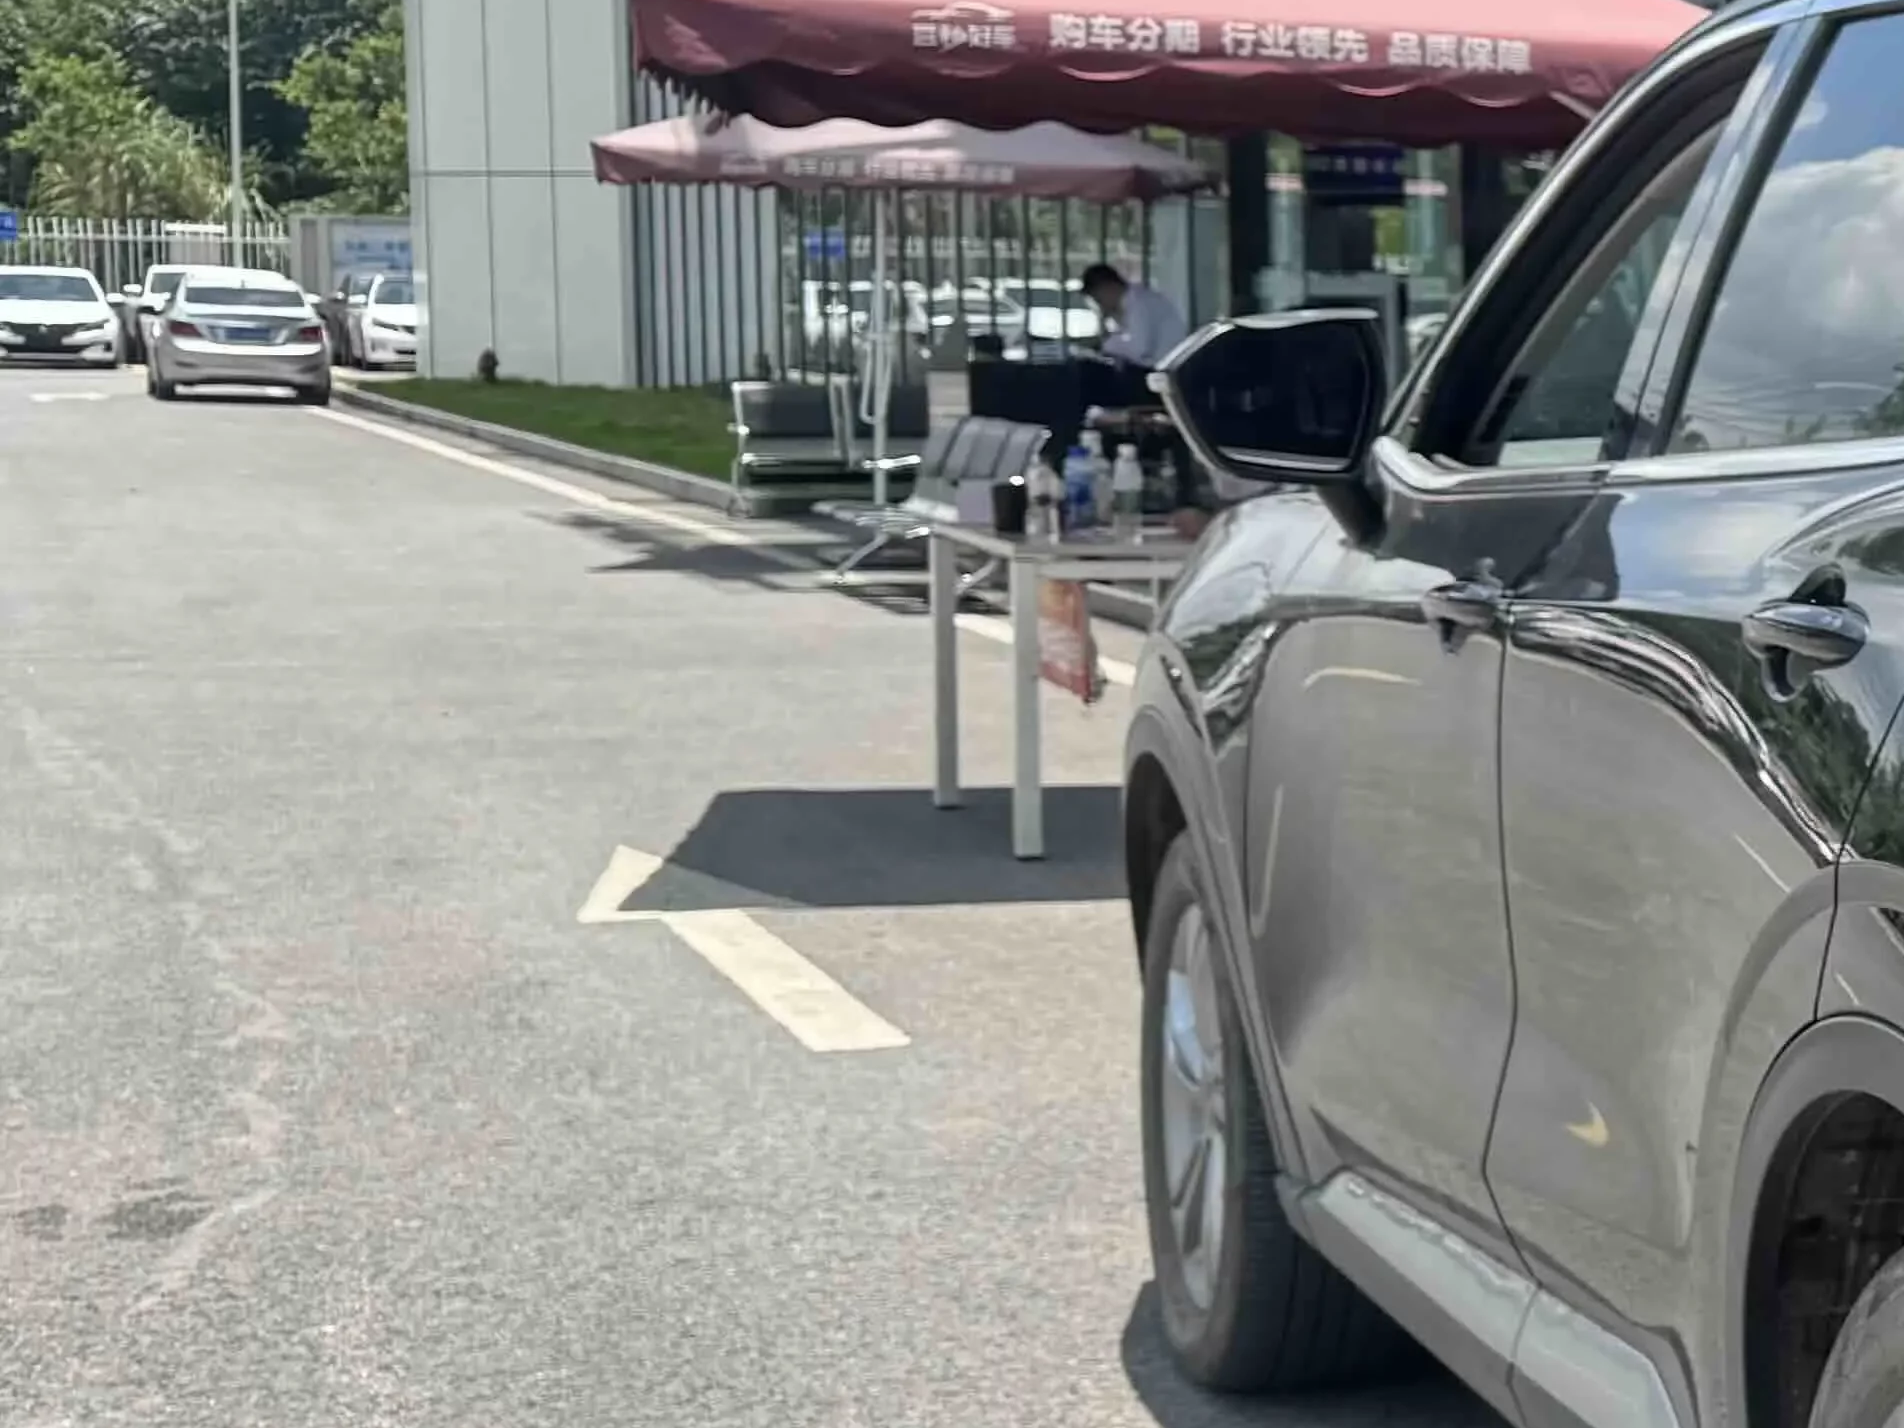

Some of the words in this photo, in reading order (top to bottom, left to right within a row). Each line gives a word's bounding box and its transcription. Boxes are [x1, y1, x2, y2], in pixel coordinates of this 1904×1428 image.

[1049, 13, 1200, 53] 购车分期
[1221, 21, 1369, 62] 行业领先
[1387, 31, 1532, 74] 品质保障
